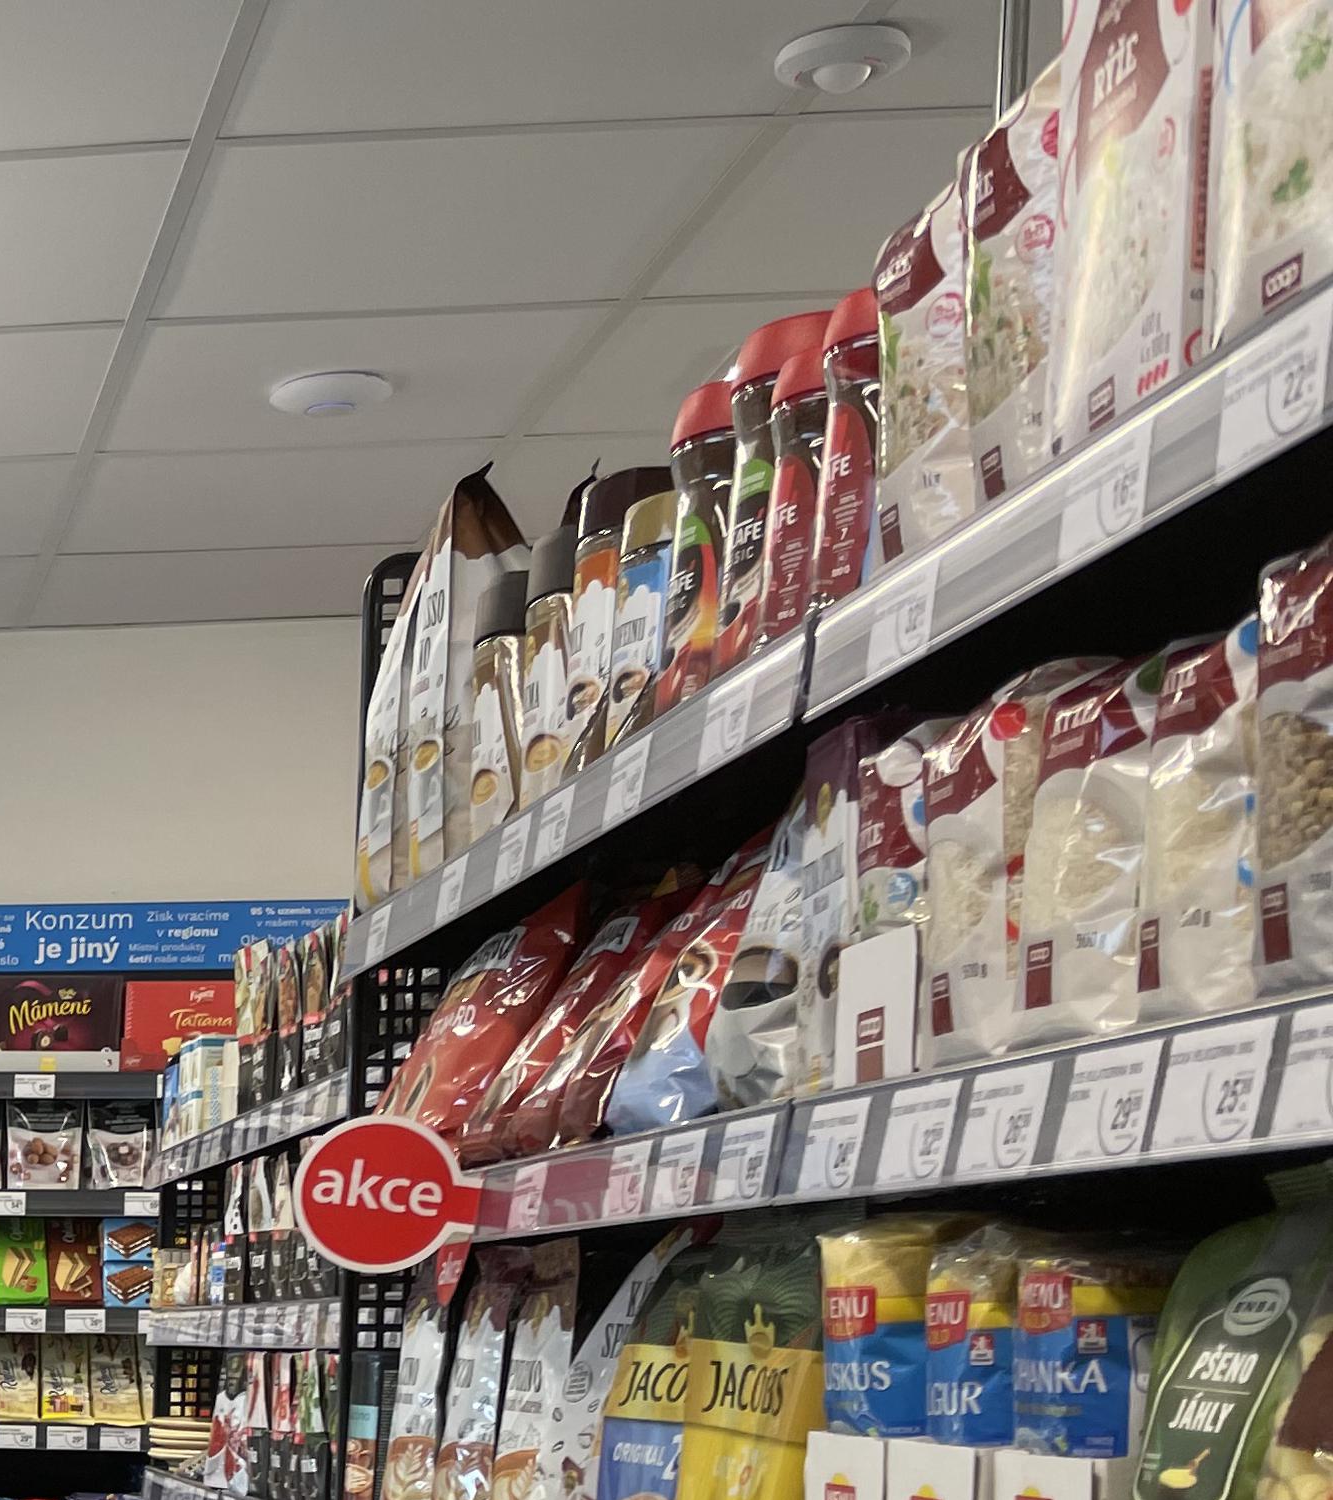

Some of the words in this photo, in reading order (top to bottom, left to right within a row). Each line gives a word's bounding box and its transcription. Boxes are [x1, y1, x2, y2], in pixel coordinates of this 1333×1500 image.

[25, 909, 134, 931] Konzum
[146, 910, 174, 922] Zisk
[177, 909, 230, 922] vracíme
[34, 937, 62, 965] je
[67, 935, 120, 965] jiný
[156, 929, 164, 938] v
[167, 926, 219, 941] regionu
[169, 1007, 233, 1032] Tatiana
[311, 1158, 443, 1217] akce
[1189, 1345, 1260, 1385] PŠENO
[618, 1360, 688, 1407] JACO
[701, 1359, 790, 1418] JACOBS
[1168, 1392, 1235, 1434] JÁHLY
